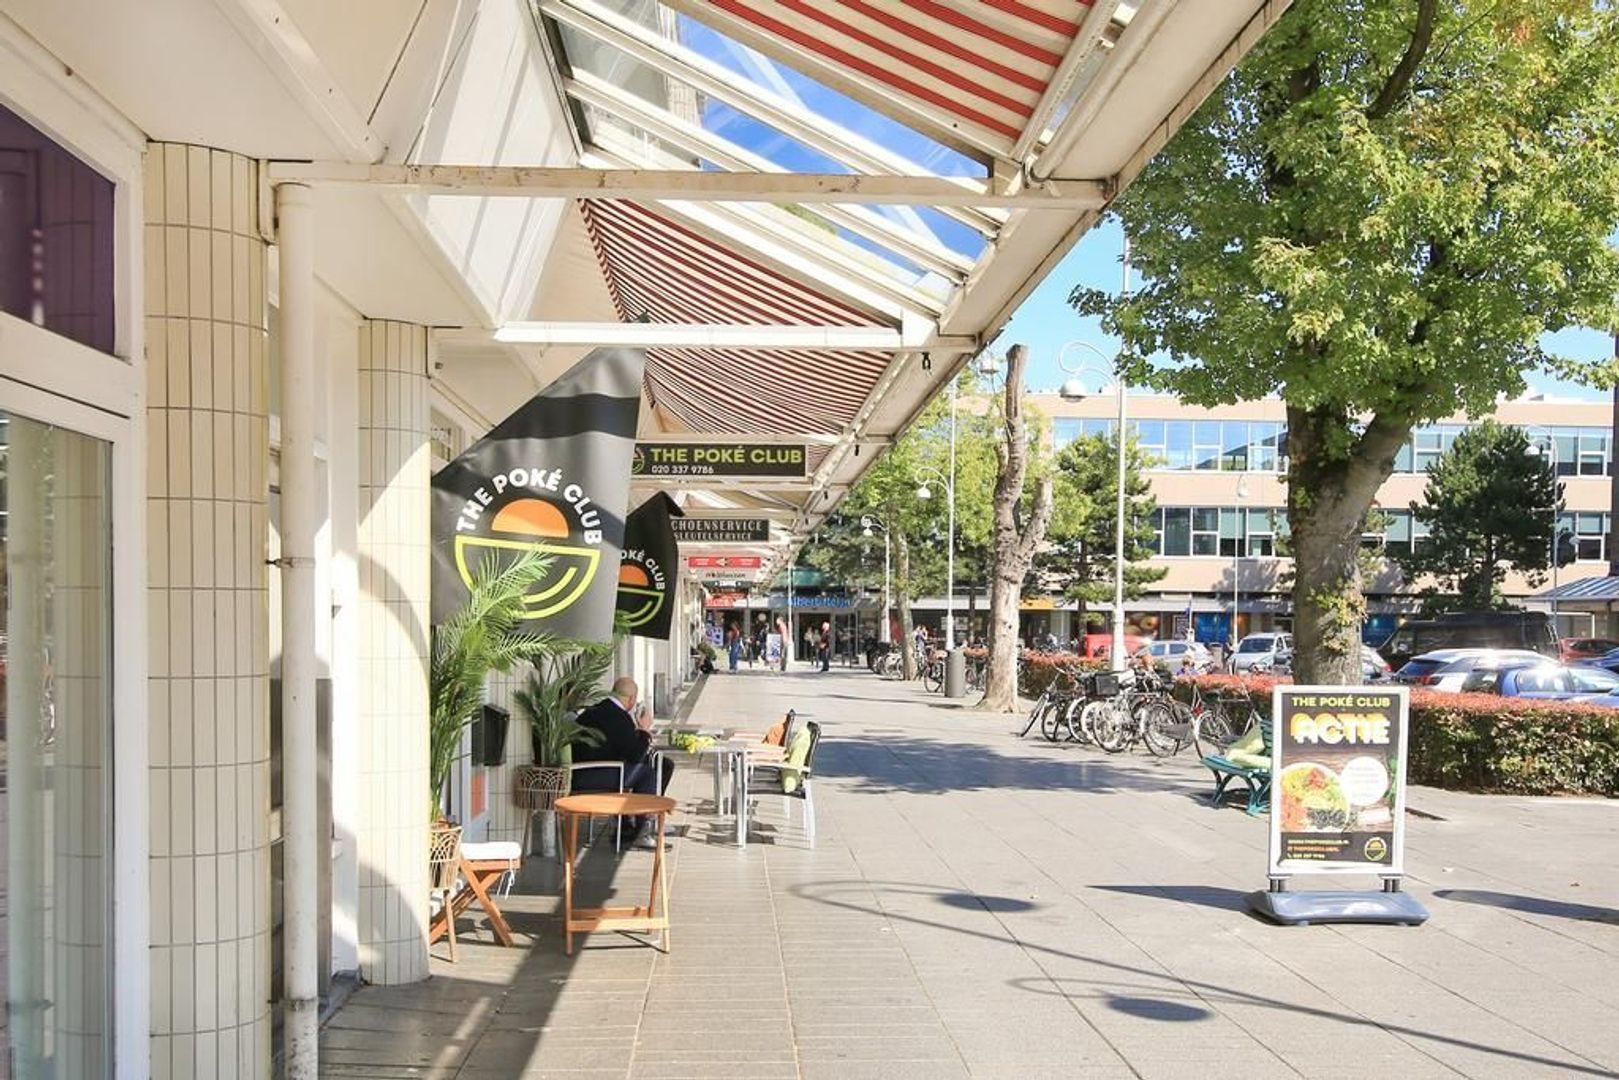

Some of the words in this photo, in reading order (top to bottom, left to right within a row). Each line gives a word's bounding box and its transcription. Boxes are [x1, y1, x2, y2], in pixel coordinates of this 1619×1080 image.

[650, 448, 688, 463] THE
[694, 445, 745, 464] POKÉ
[751, 448, 803, 464] CLUB
[651, 465, 670, 474] 020
[671, 465, 688, 474] 337
[691, 465, 715, 475] 9786
[456, 487, 494, 532] THE
[492, 468, 563, 494] POKÉ
[563, 483, 603, 545] CLUB
[670, 519, 763, 531] CHOENSERVICE
[620, 549, 645, 562] OKÉ
[645, 558, 666, 590] CLUB
[1291, 697, 1317, 707] THE
[1320, 694, 1354, 707] POKÉ
[1356, 697, 1392, 707] CLUB
[1291, 713, 1392, 744] ACTIE
